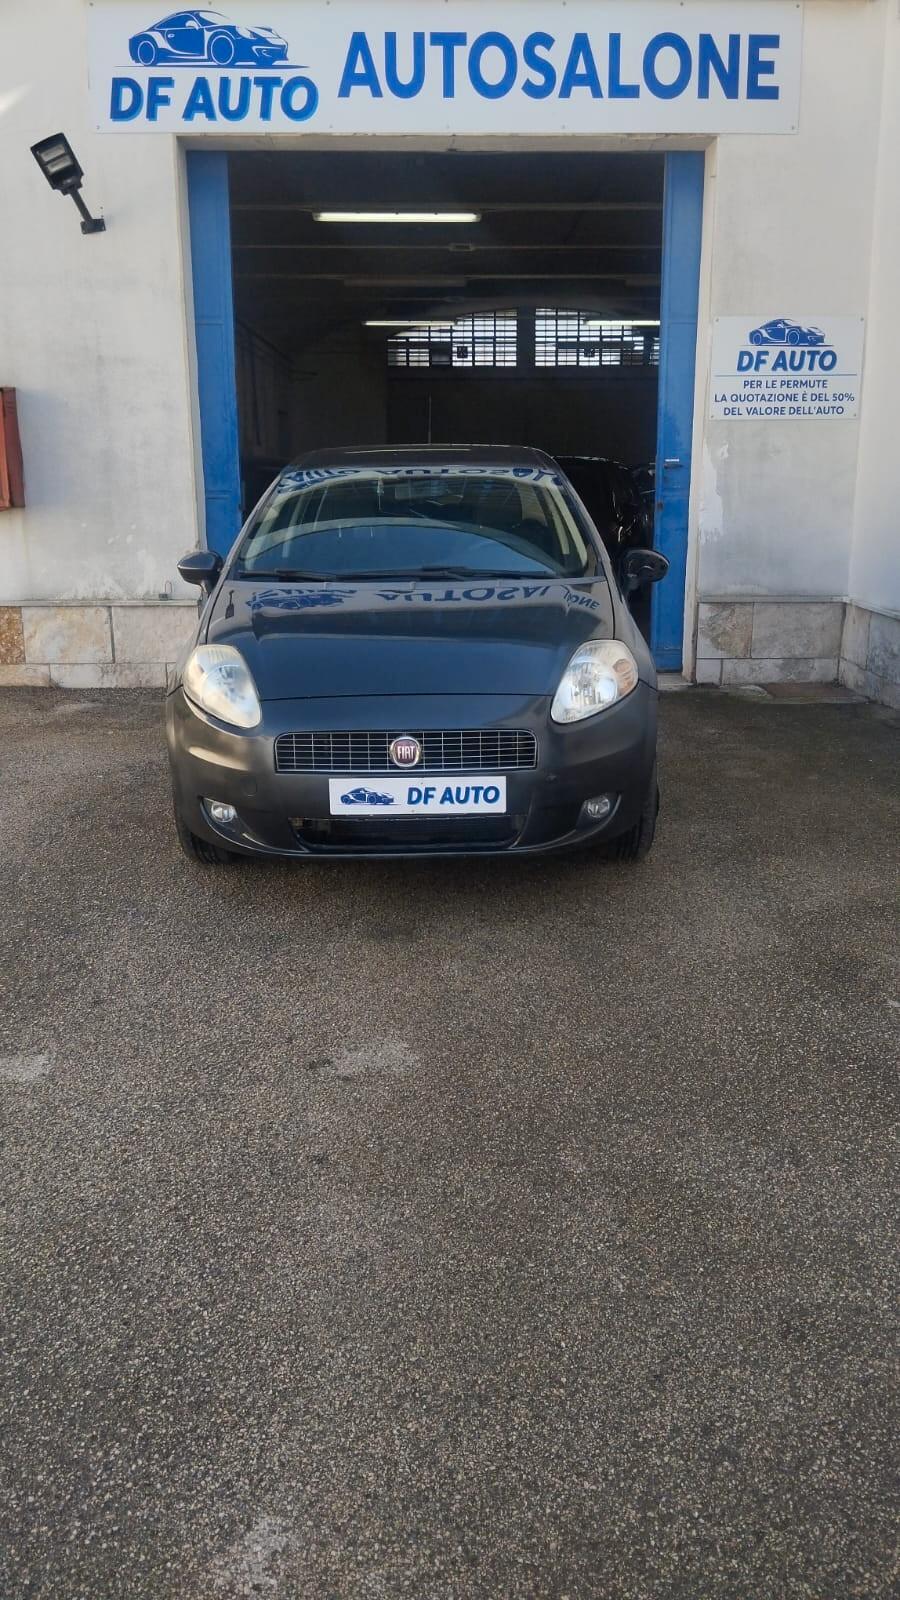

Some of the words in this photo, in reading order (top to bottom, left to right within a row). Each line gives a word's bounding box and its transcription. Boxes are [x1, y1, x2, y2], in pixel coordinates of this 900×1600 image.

[337, 31, 780, 100] AUTOSALONE
[109, 76, 175, 122] DF
[182, 75, 320, 122] AUTO
[736, 350, 770, 372] DF
[771, 349, 838, 372] AUTO
[743, 380, 763, 389] PER
[765, 380, 778, 389] LE
[780, 379, 828, 389] PERMUTE
[714, 394, 728, 403] LA
[730, 393, 799, 403] QUOTAZIONE
[801, 390, 808, 402] È
[810, 393, 830, 402] DEL
[832, 393, 855, 402] 50%
[723, 407, 743, 416] DEL
[745, 406, 786, 416] VALORE
[788, 406, 845, 415] DELL'AUTO
[397, 745, 415, 760] FIAT
[407, 786, 436, 805] DF
[439, 785, 500, 804] AUTO
